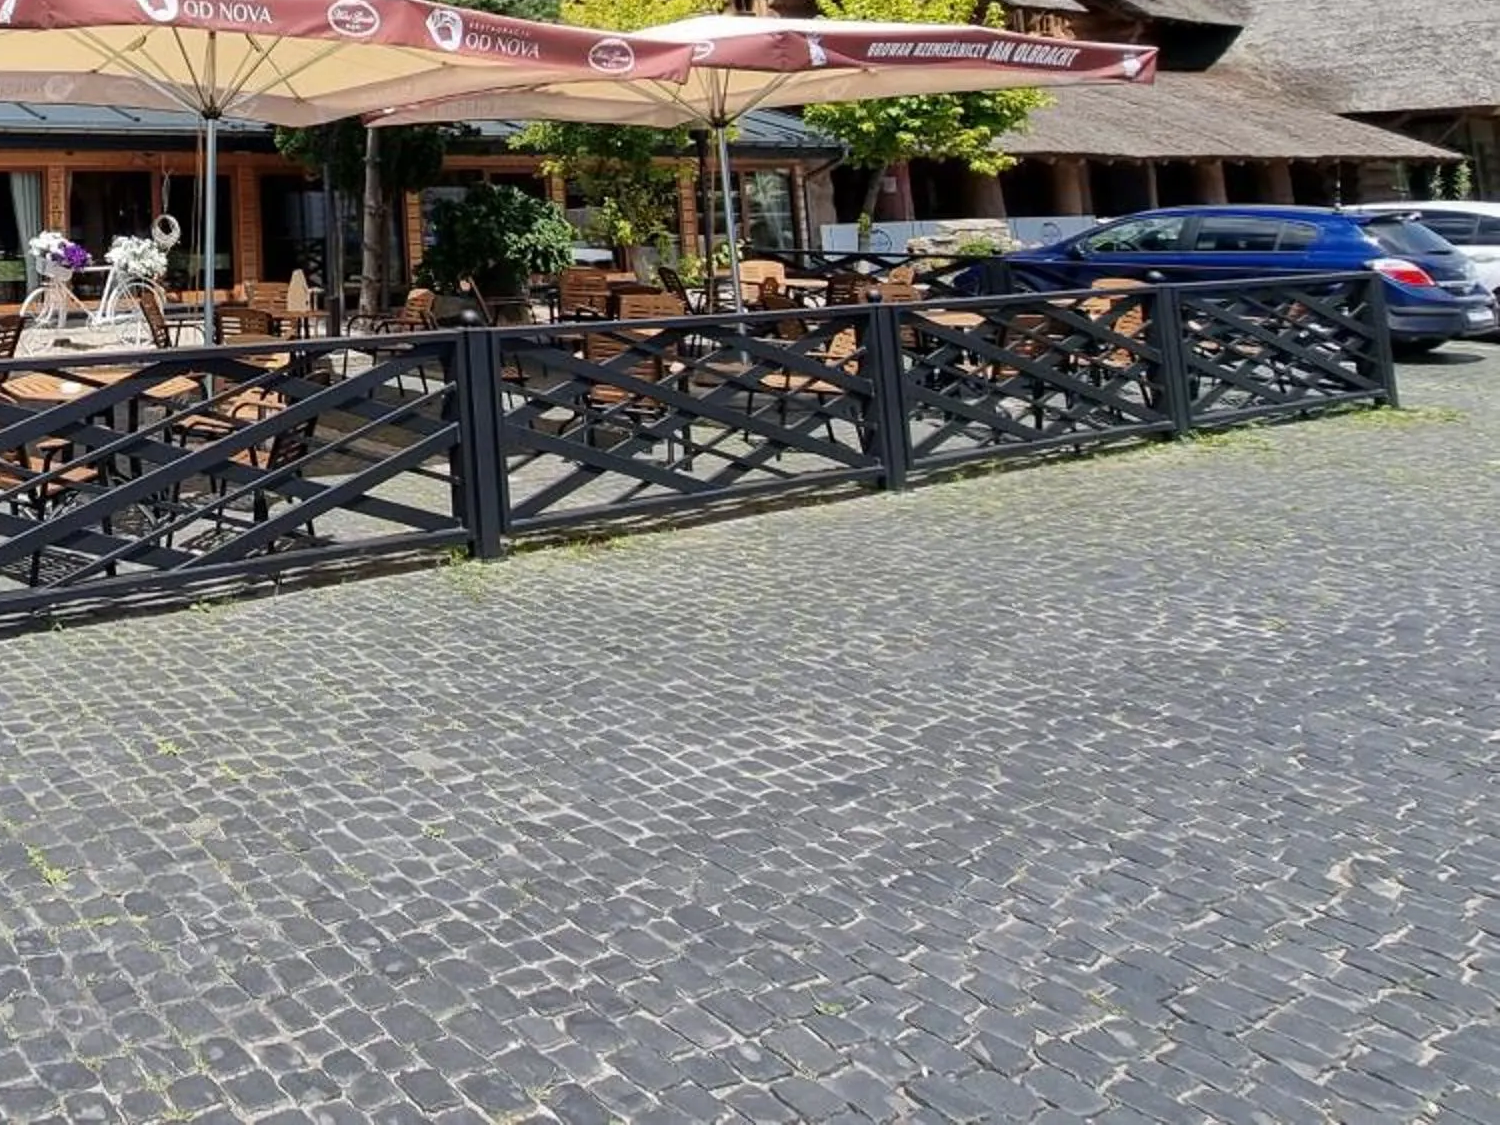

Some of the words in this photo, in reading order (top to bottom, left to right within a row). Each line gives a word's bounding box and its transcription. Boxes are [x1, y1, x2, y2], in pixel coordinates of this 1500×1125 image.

[183, 0, 214, 20] OD
[219, 2, 274, 24] NOVA
[465, 32, 491, 52] OD
[495, 37, 541, 59] NOVA
[986, 40, 1016, 62] JAN
[1013, 43, 1081, 67] OLBRACHT
